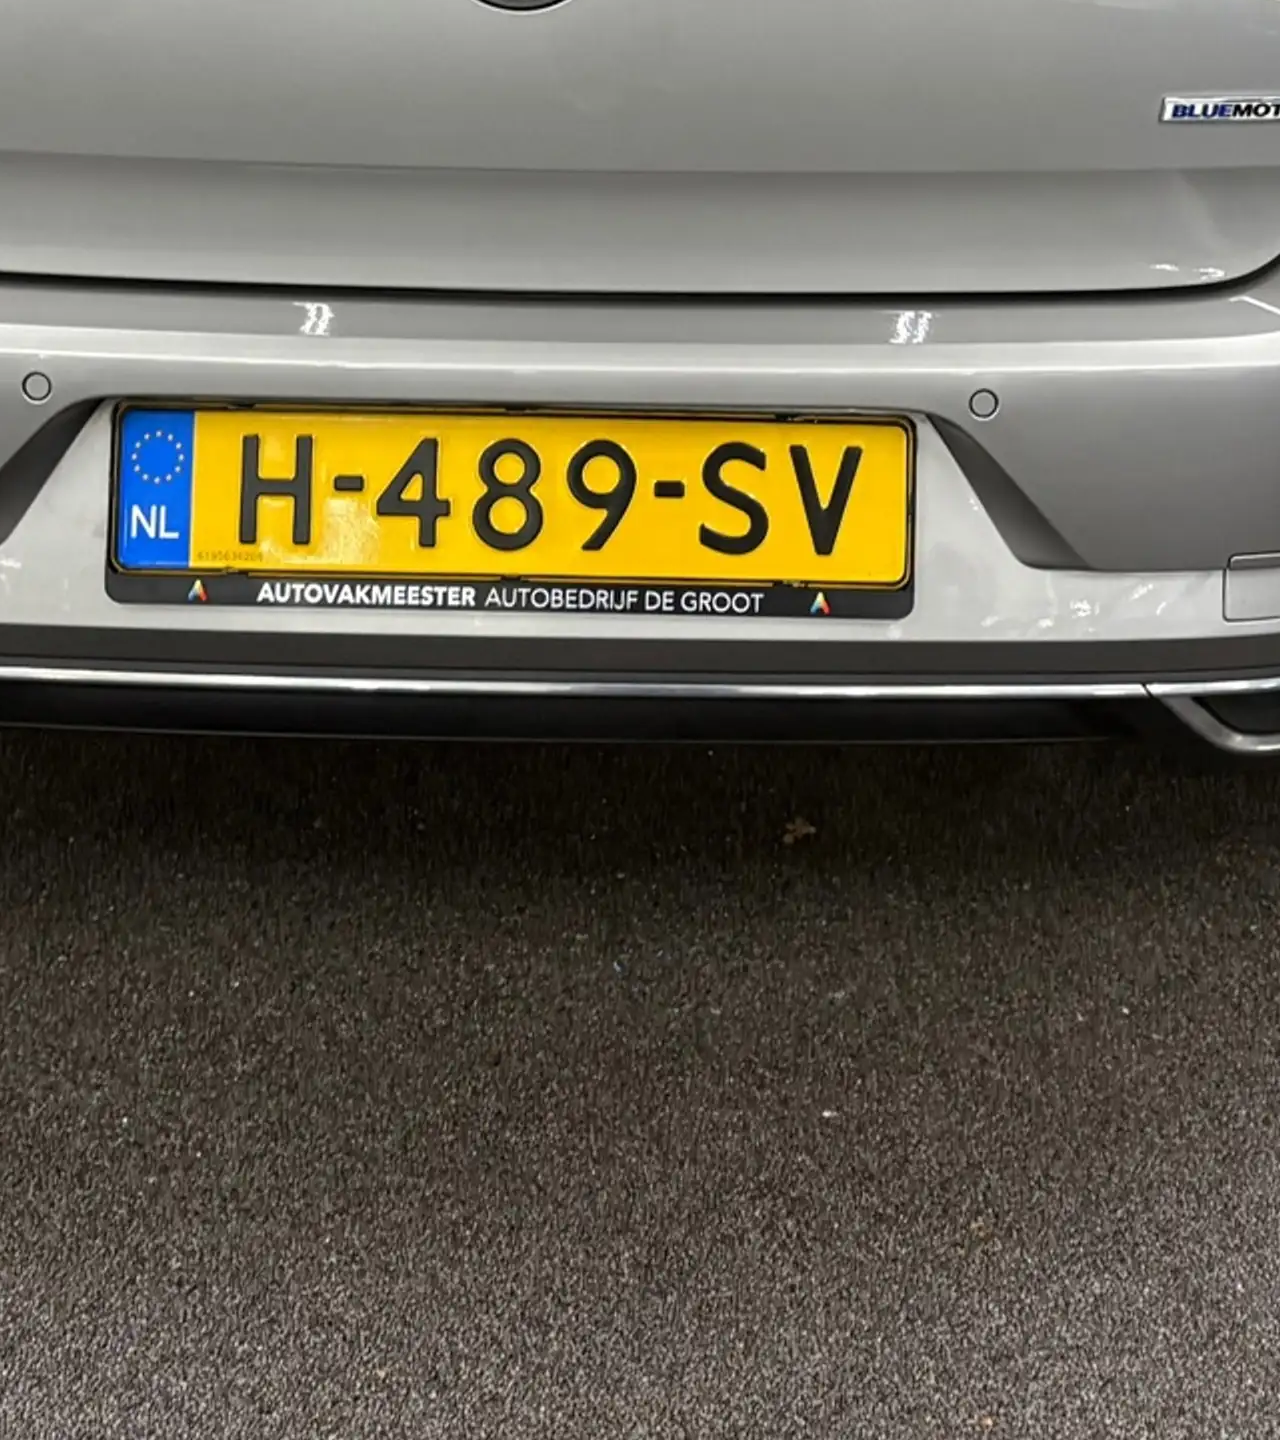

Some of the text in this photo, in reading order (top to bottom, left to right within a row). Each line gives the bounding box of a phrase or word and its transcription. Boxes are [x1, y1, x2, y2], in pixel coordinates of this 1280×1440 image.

[238, 433, 863, 557] H-489-SV
[129, 504, 180, 540] NL
[256, 581, 765, 614] AUTOVAKMEESTER AUTOBEDRIJF DE GROOT
